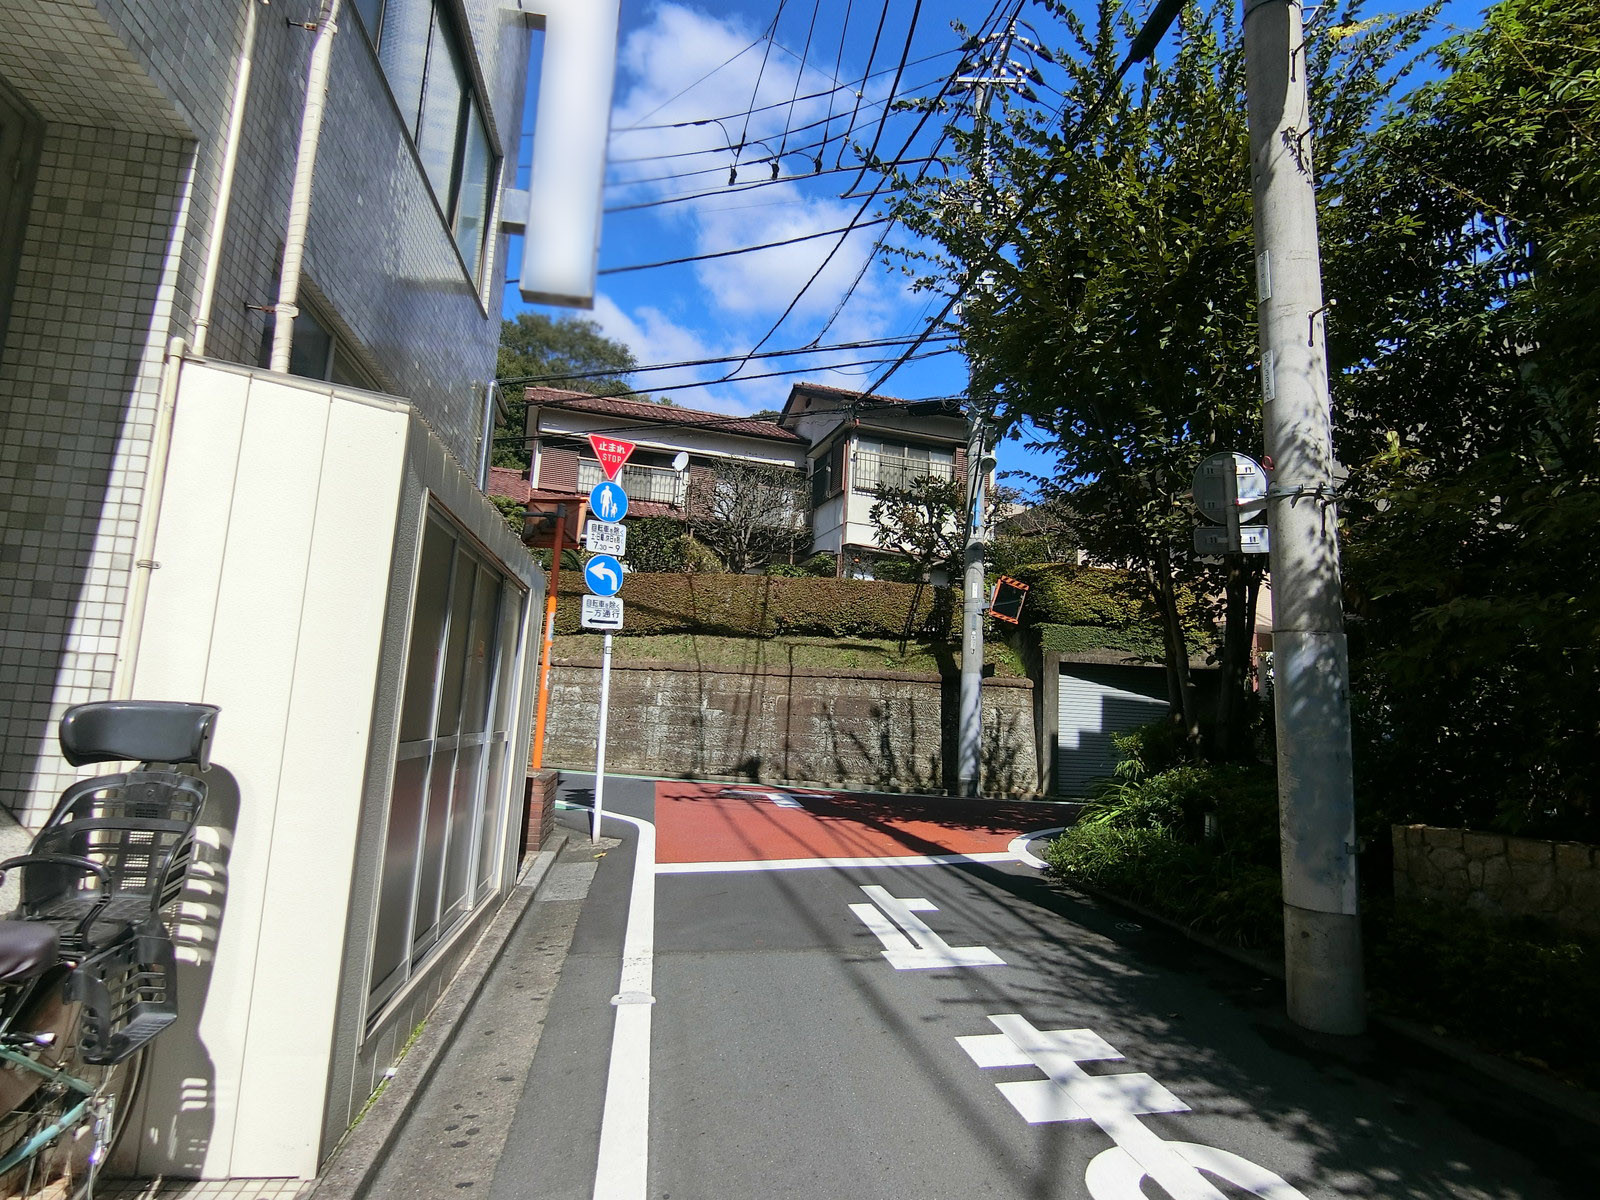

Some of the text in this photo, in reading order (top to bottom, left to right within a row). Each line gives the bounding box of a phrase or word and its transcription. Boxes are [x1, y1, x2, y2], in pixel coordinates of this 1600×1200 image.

[598, 441, 626, 455] 止まれ
[602, 453, 622, 464] STOP
[591, 523, 624, 537] 自転車を除く
[586, 598, 620, 610] 自転車を除く
[585, 609, 620, 619] 一方通行
